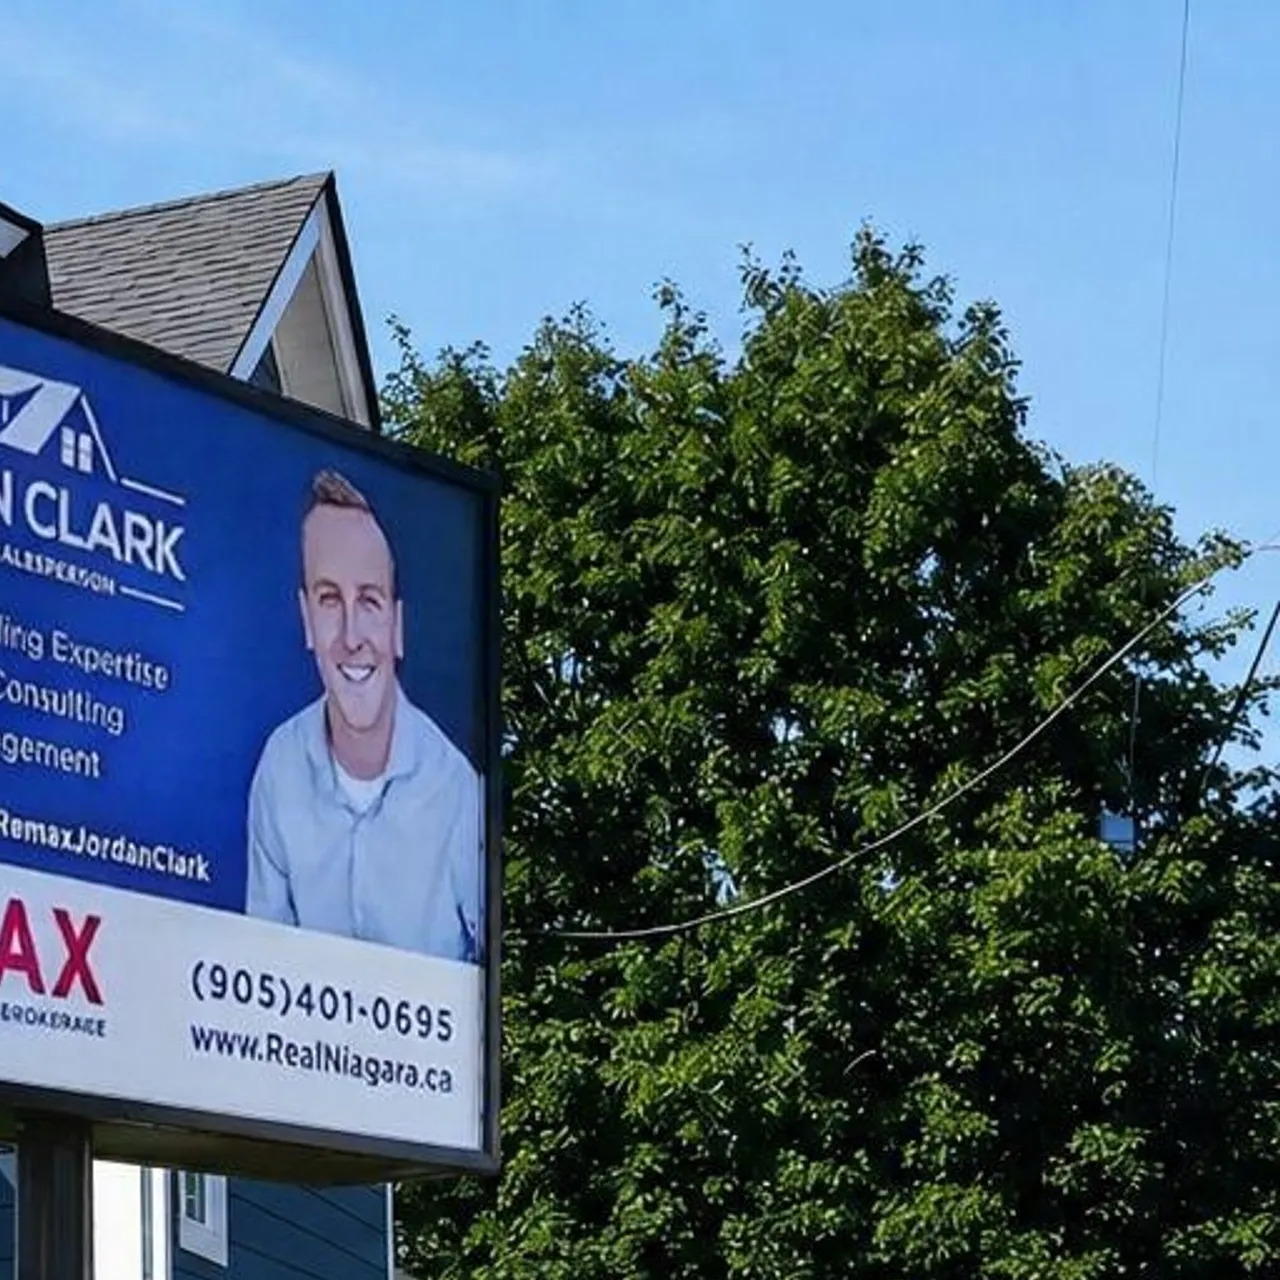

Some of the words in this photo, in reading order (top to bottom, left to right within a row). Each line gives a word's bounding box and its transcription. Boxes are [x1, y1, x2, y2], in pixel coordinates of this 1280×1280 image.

[25, 480, 186, 581] CLARK
[51, 629, 170, 691] Expertise
[191, 960, 453, 1042] (905)401-0695
[190, 1024, 453, 1094] www.RealNiagara.ca
